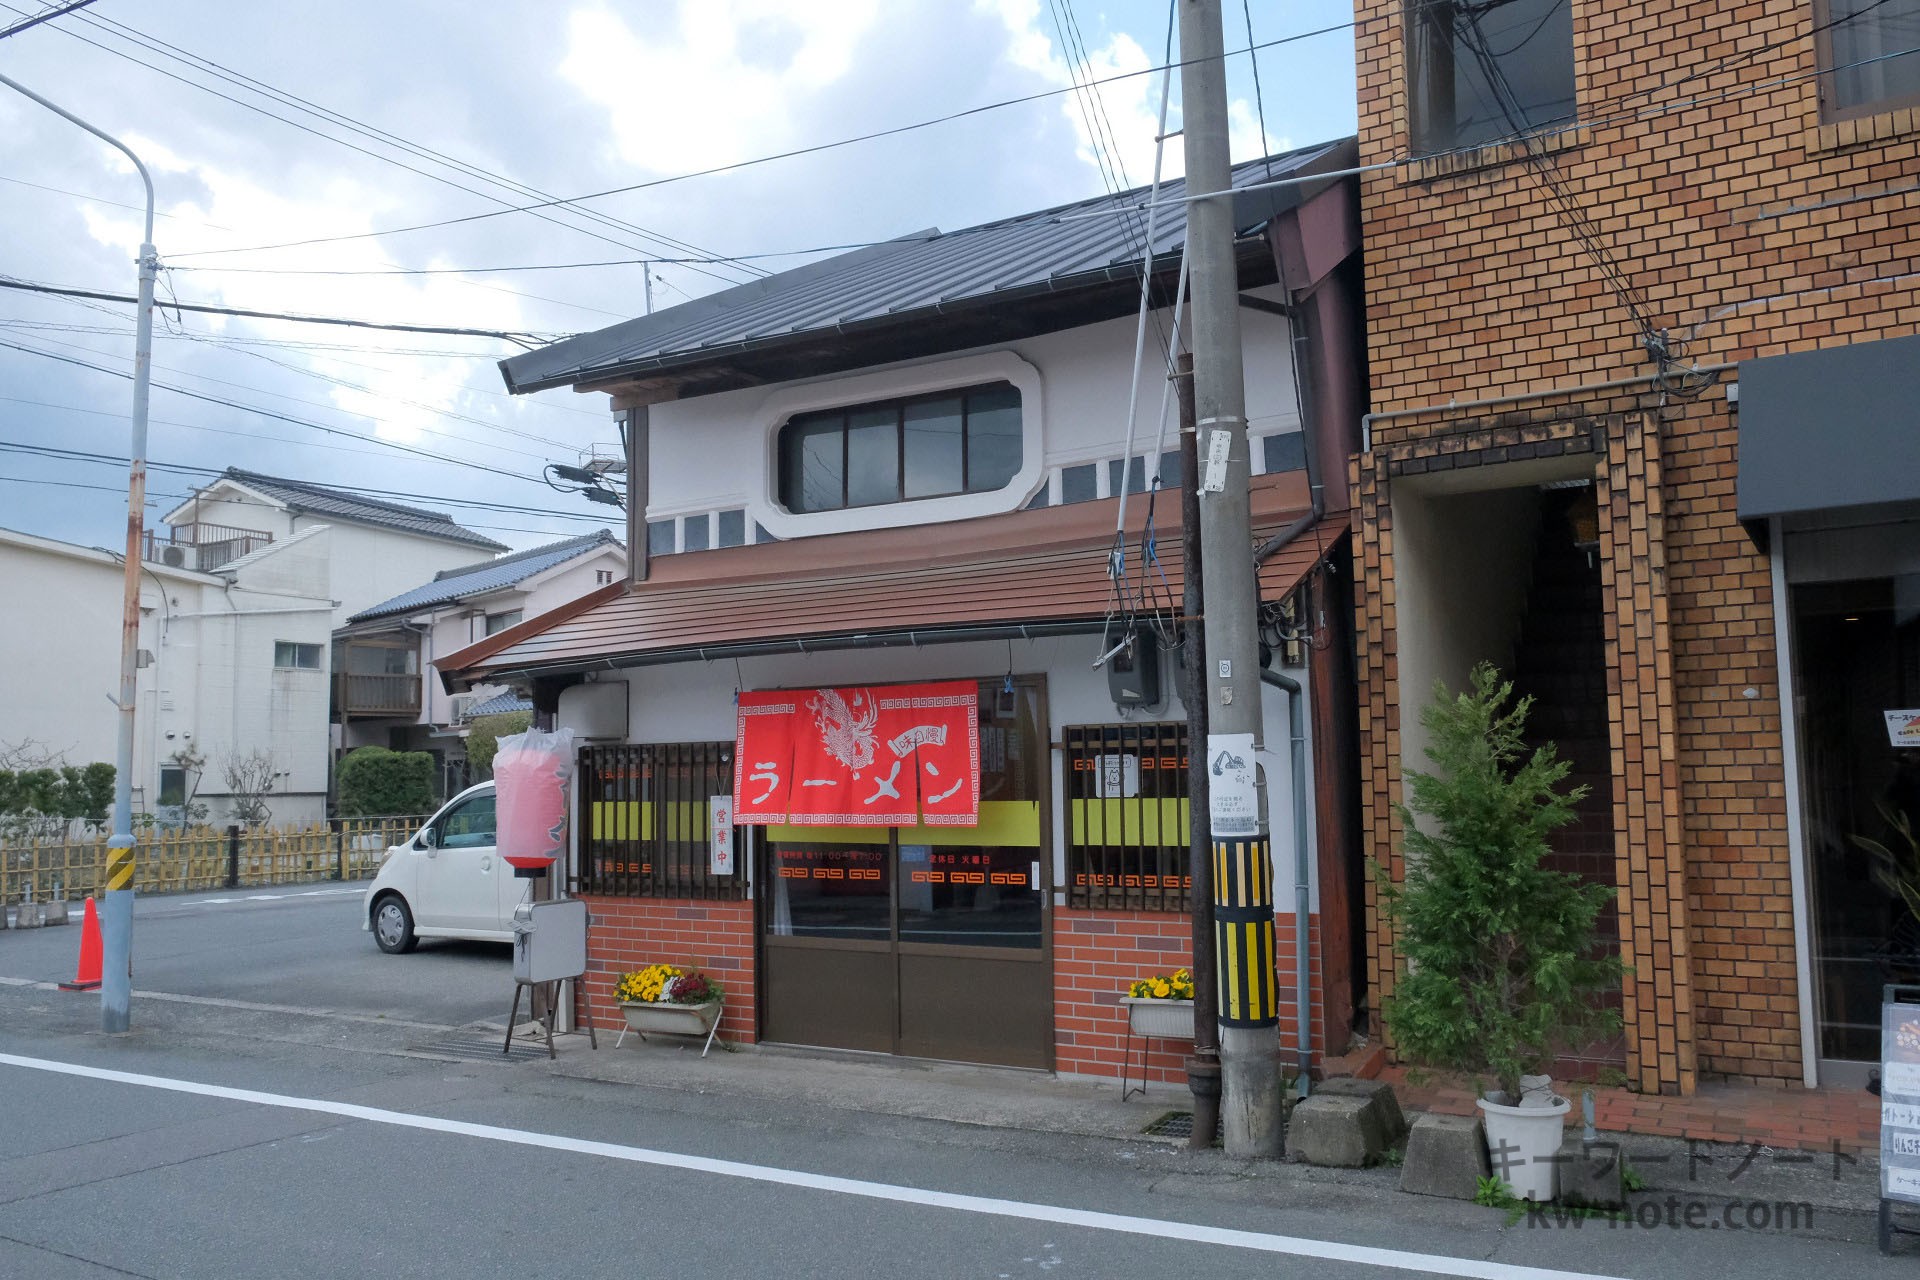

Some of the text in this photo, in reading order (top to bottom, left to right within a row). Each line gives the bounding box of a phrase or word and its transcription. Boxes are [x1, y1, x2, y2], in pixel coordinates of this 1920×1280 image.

[898, 727, 939, 750] 味自慢
[749, 760, 963, 805] ラーメン
[716, 808, 728, 866] 営業中
